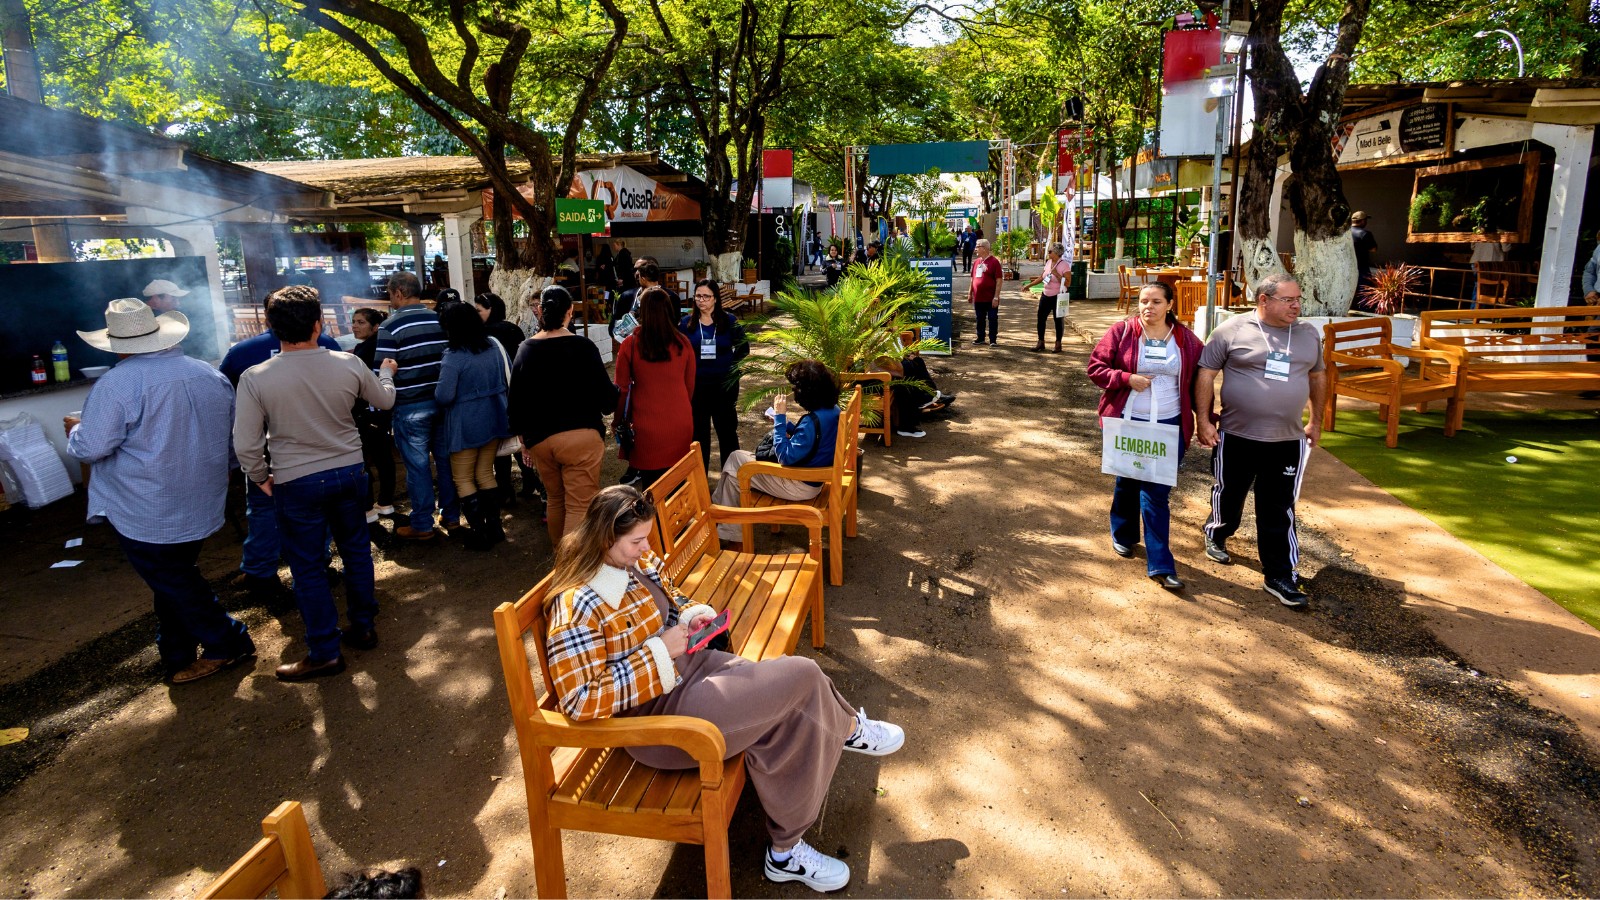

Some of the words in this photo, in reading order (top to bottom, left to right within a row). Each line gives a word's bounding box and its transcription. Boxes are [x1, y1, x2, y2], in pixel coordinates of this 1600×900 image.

[1378, 136, 1391, 146] Belle
[620, 188, 667, 210] CoisaRara
[559, 209, 587, 222] SAÍDA
[1114, 435, 1167, 457] LEMBRAR
